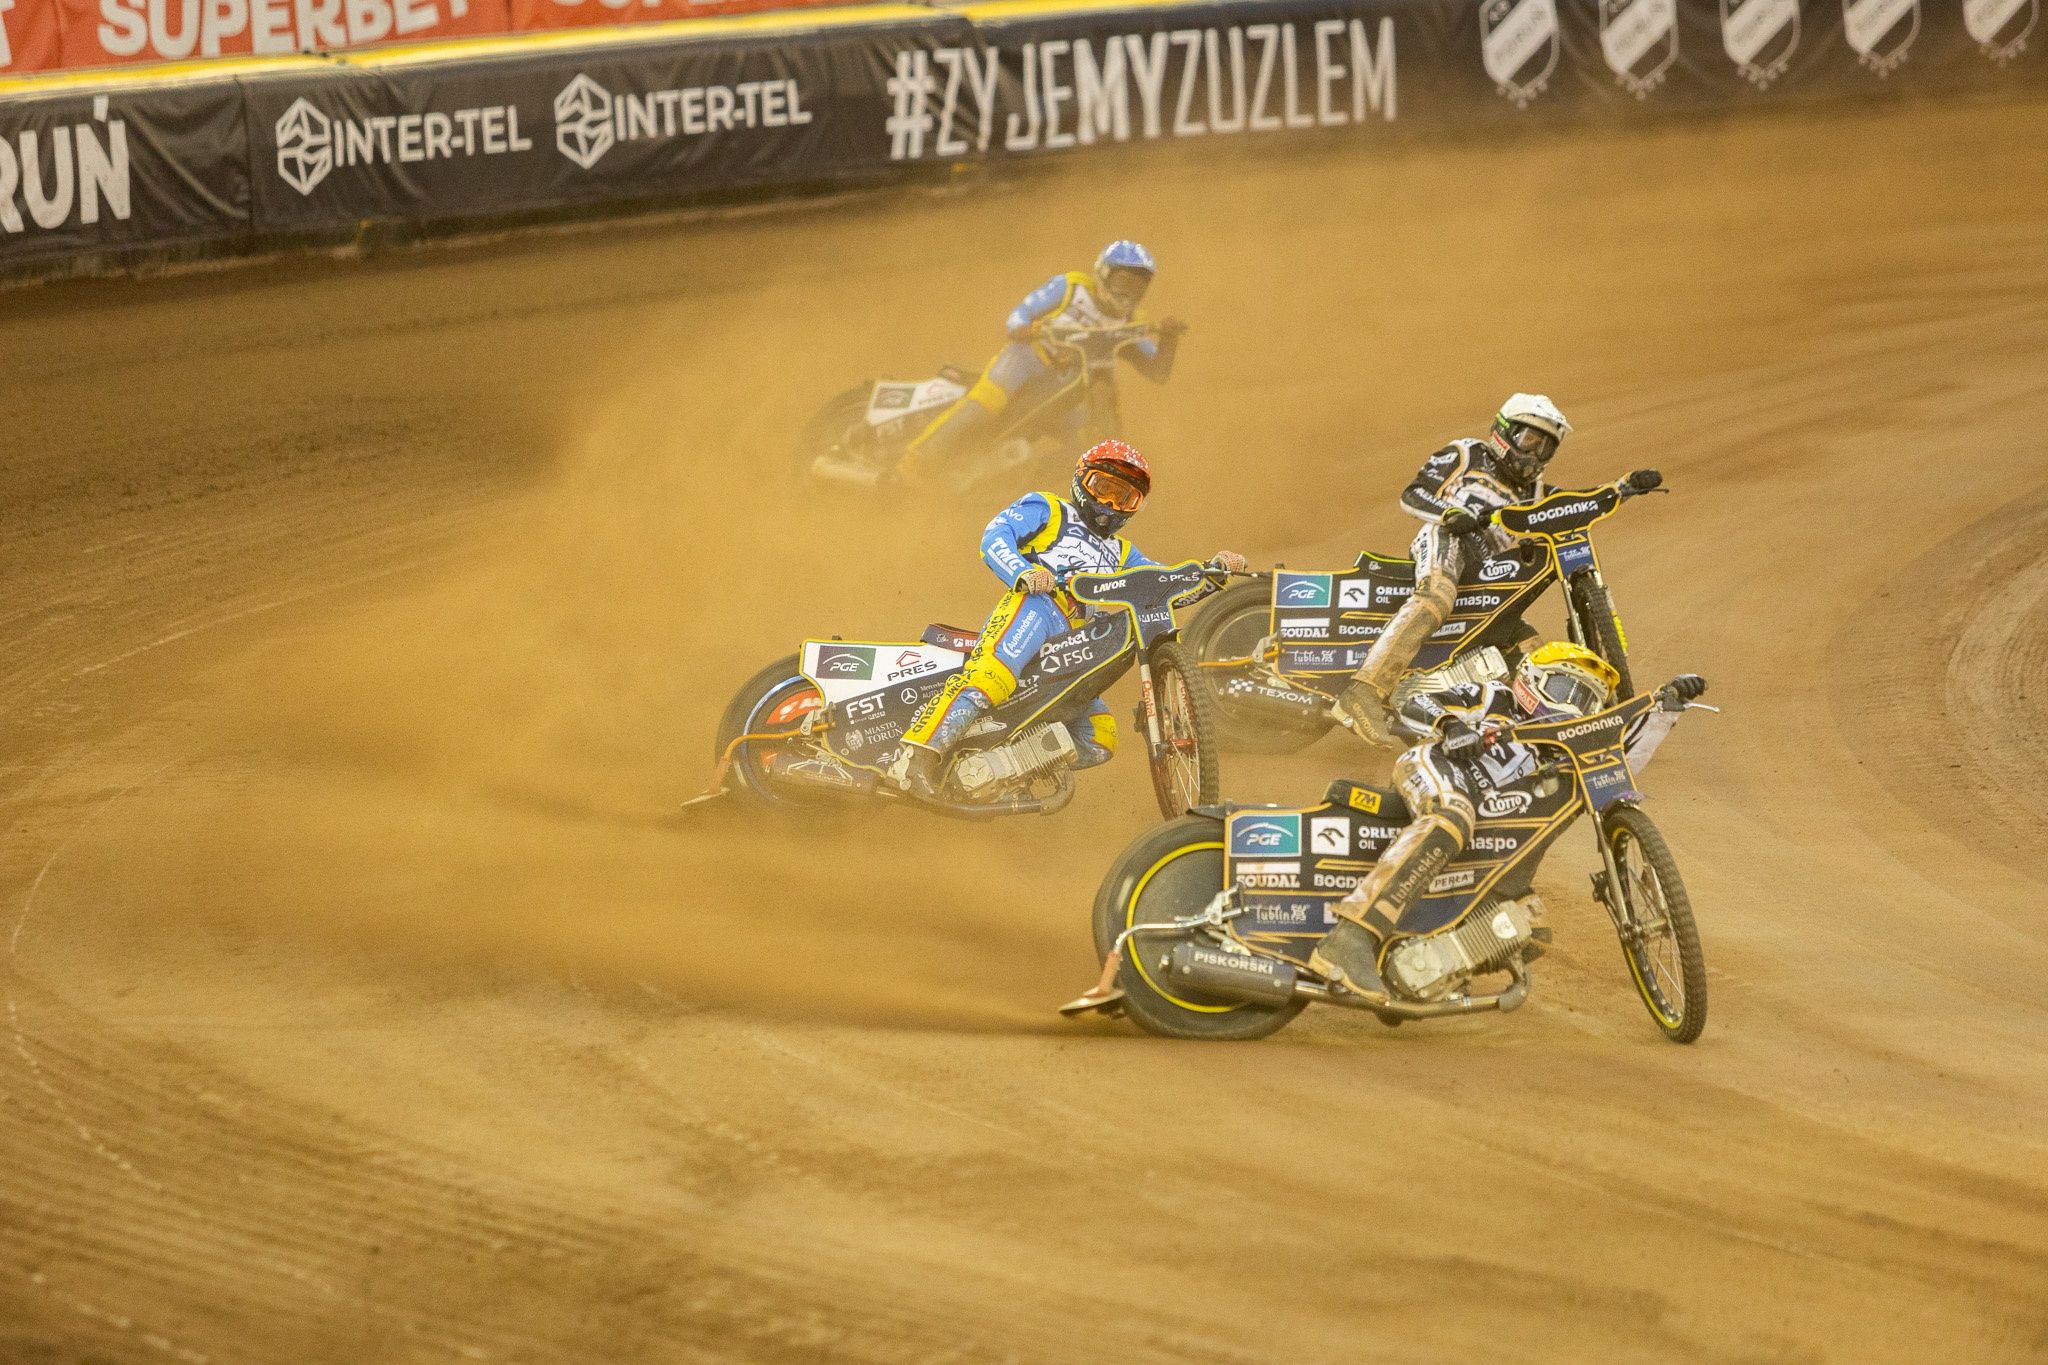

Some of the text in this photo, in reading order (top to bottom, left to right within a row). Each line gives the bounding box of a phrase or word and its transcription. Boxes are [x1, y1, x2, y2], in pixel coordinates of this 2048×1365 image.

[98, 0, 471, 60] SUPERBE
[615, 79, 813, 142] INTER-TEL
[334, 105, 533, 167] INTER-TEL
[1527, 500, 1599, 525] BOGDANKA
[1487, 562, 1513, 577] LOTTO
[1093, 579, 1127, 594] LAVOR
[1288, 589, 1316, 600] PGE
[1376, 596, 1390, 604] OIL
[1455, 595, 1501, 607] maspo
[1280, 627, 1330, 638] SOUDAL
[1040, 630, 1090, 658] Pentel
[1063, 646, 1094, 667] FSG
[829, 662, 860, 672] PGE
[888, 660, 938, 681] PRES
[1257, 686, 1314, 705] TEXOM
[846, 693, 885, 719] FST
[864, 720, 897, 735] MIASTO
[1557, 714, 1624, 741] BOGDANKA
[1488, 796, 1522, 812] LOTTO
[1247, 833, 1282, 846] PGE
[1358, 839, 1378, 850] OIL
[1236, 874, 1300, 888] SOUDAL
[1434, 874, 1468, 888] PERŁA
[1194, 951, 1274, 975] PISKORSKI
